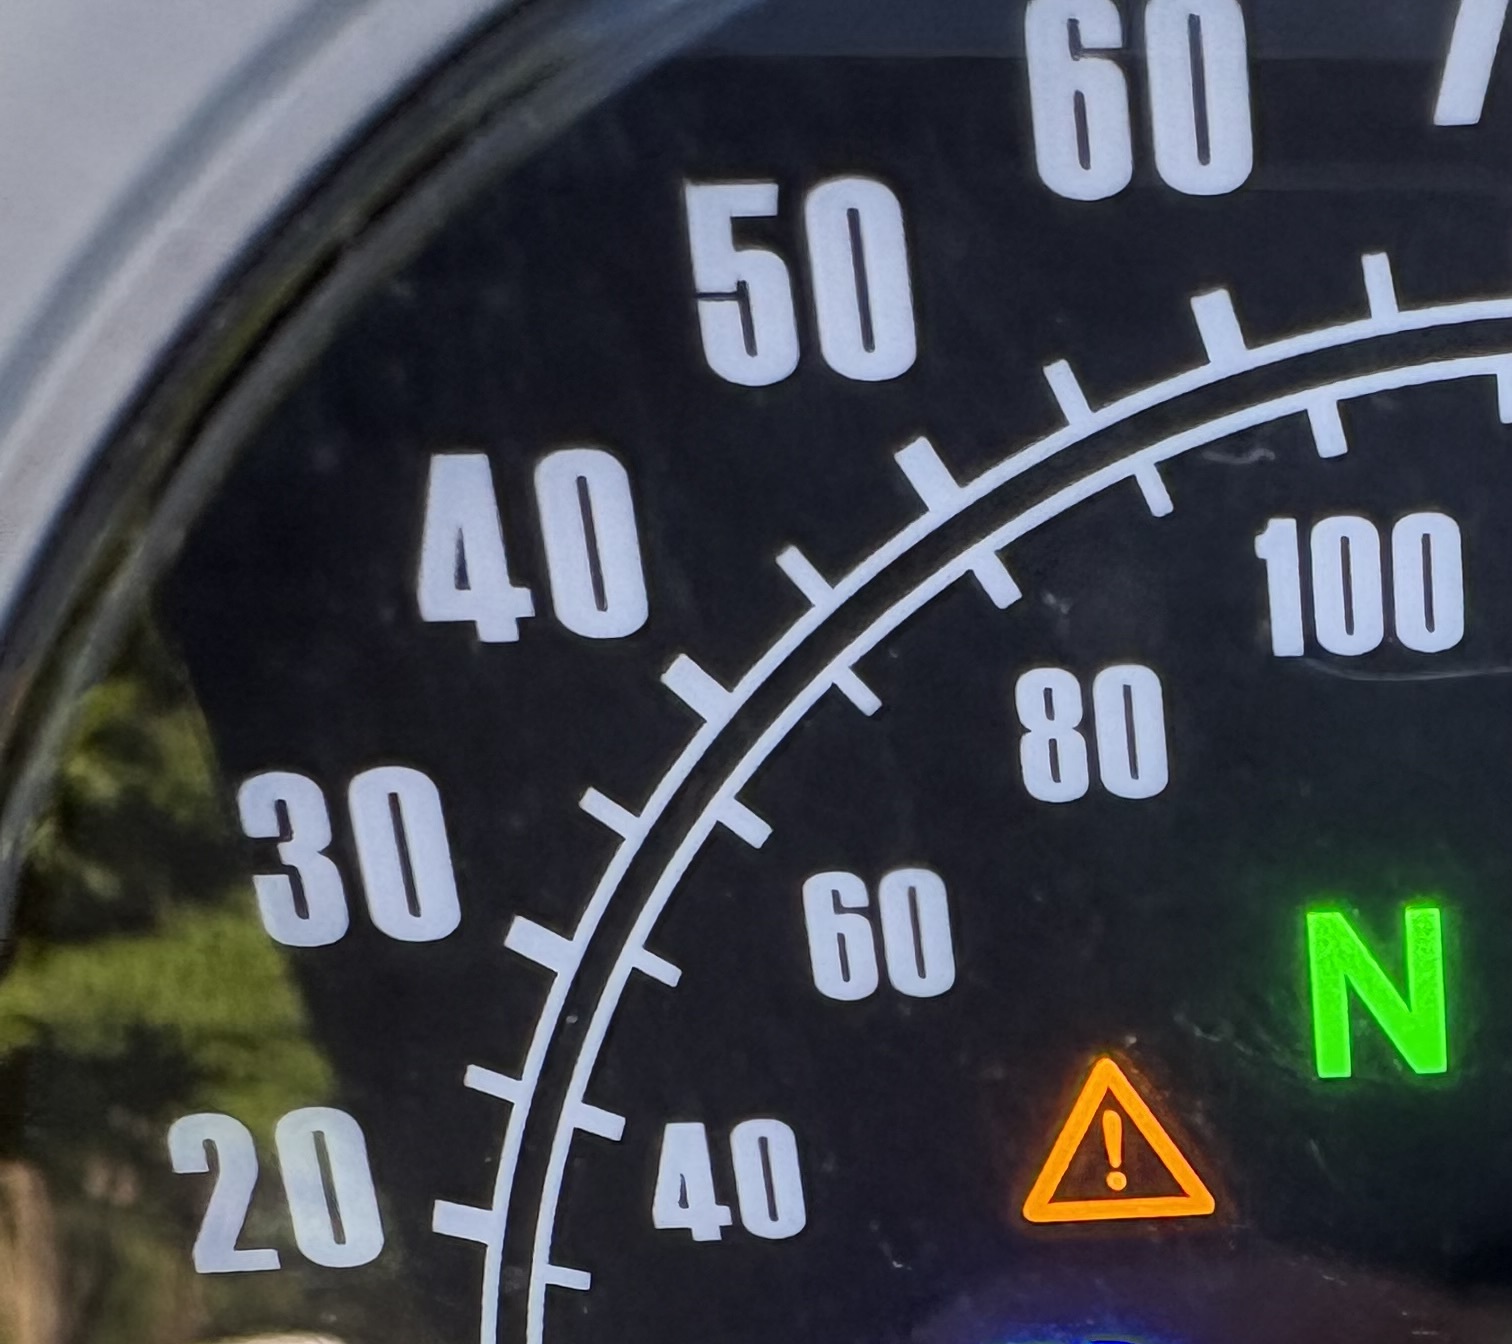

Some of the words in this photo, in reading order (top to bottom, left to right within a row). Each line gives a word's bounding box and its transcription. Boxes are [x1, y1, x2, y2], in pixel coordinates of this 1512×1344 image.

[1023, 0, 1254, 200] 60
[684, 176, 917, 386] 50
[418, 448, 649, 643] 40
[1255, 512, 1464, 656] 100
[1015, 664, 1169, 802] 80
[237, 765, 461, 947] 30
[803, 868, 956, 1000] 60
[1306, 906, 1448, 1078] N
[167, 1106, 384, 1273] 20
[652, 1119, 805, 1241] 40
